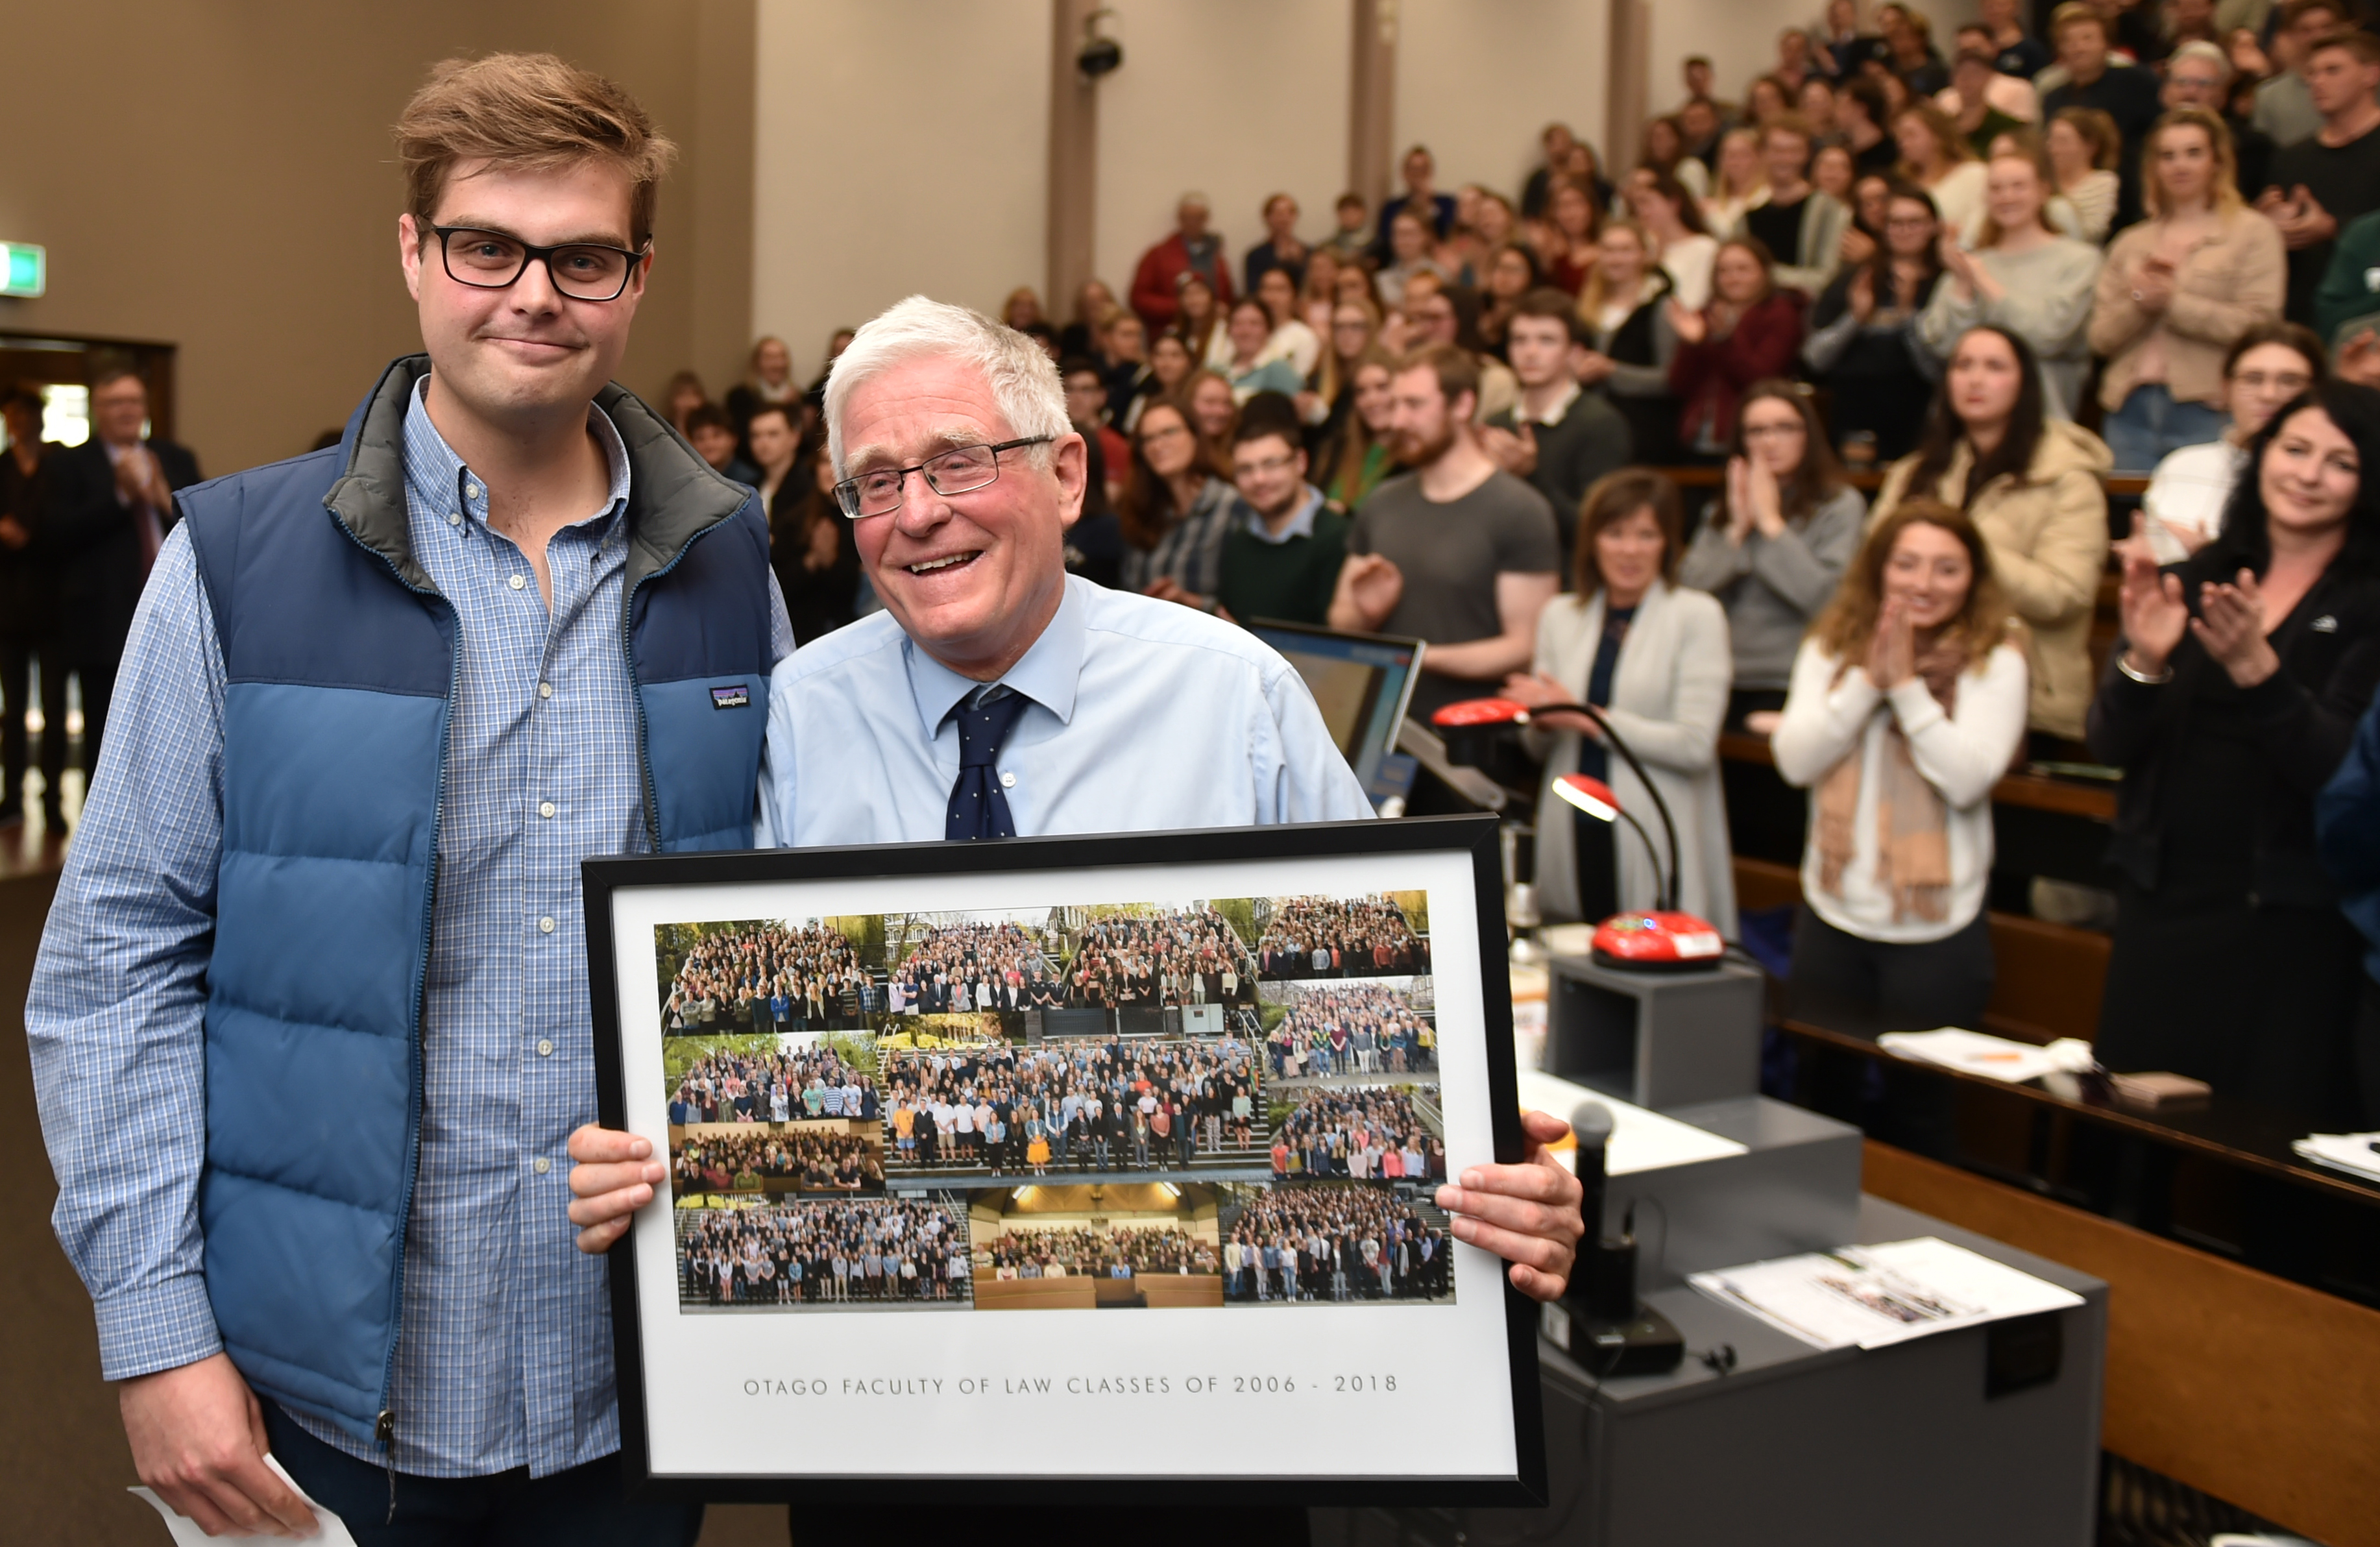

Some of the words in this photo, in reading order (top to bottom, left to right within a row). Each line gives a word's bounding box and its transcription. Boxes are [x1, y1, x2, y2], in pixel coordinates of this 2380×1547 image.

[744, 1379, 827, 1396] OTAGO
[843, 1378, 943, 1395] FACULTY
[958, 1378, 990, 1395] OF
[1005, 1378, 1051, 1395] LAW
[1067, 1376, 1170, 1394] CLASSES
[1185, 1376, 1218, 1393] OF
[1233, 1376, 1295, 1393] 2006
[1334, 1375, 1397, 1393] 2018
